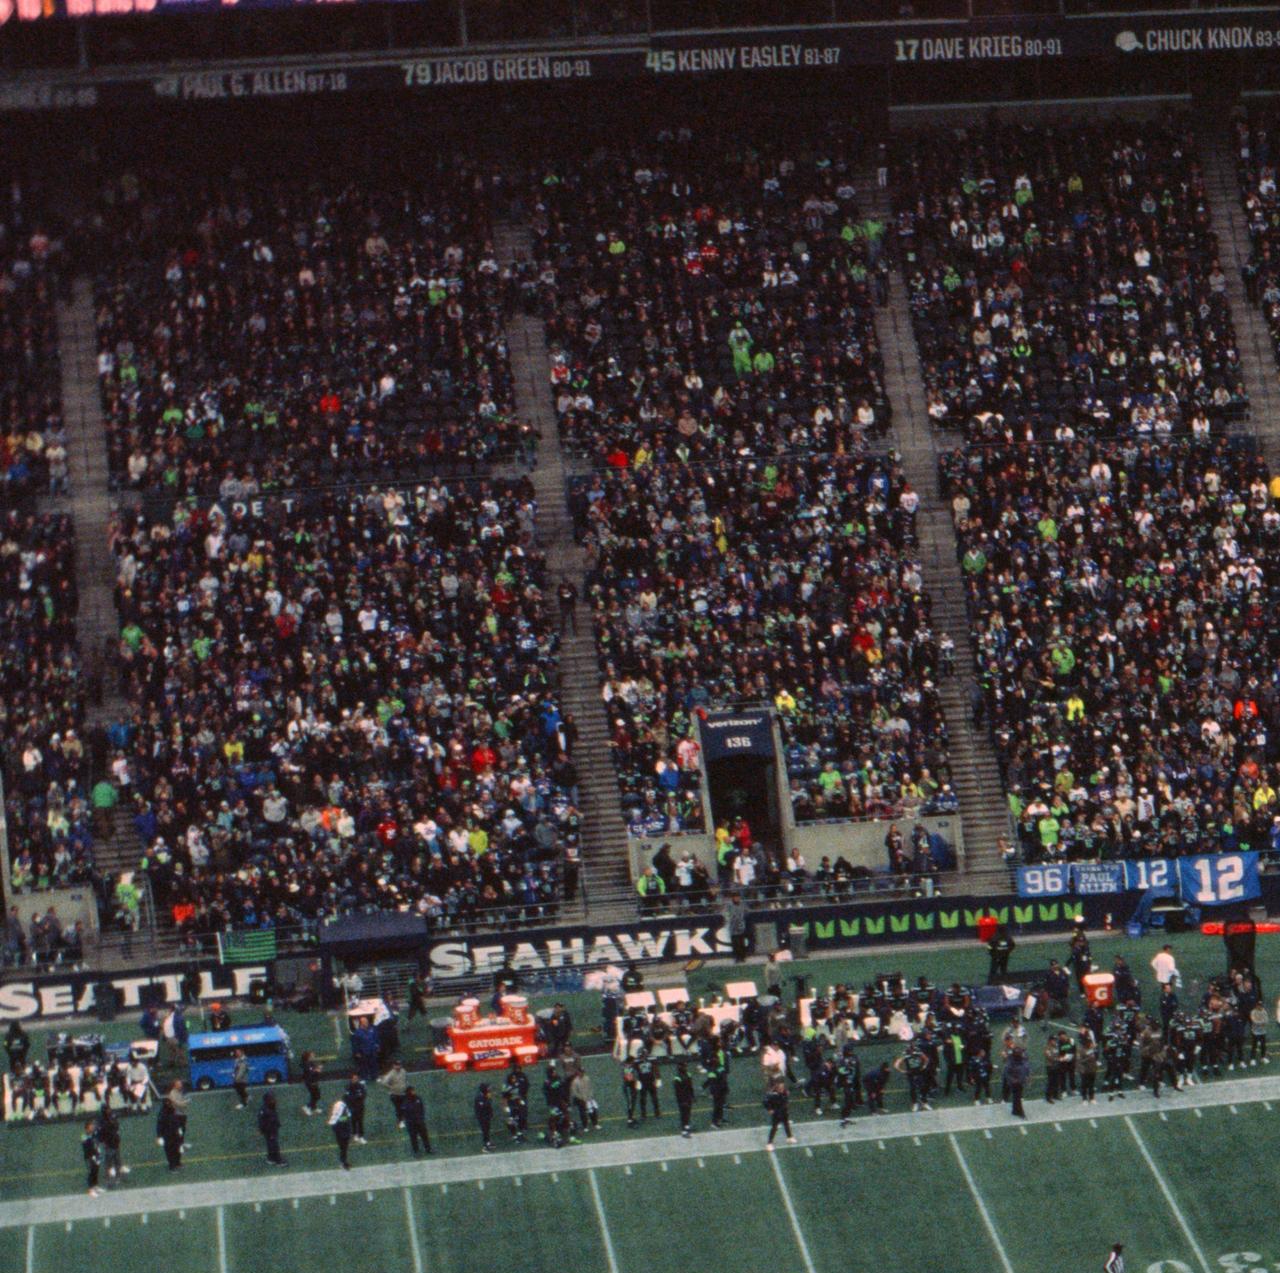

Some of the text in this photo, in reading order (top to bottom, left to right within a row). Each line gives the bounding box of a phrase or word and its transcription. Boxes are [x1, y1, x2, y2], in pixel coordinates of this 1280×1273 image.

[895, 36, 1063, 61] 17 DAVE KRIEG 80-91
[1145, 28, 1204, 53] CHUCK
[1207, 26, 1255, 50] KNOX
[645, 50, 676, 72] 45
[679, 47, 736, 71] KENNY
[740, 45, 802, 69] EASLEY
[254, 71, 306, 96] ALLEN
[402, 61, 432, 86] 79
[434, 60, 488, 85] JACOB
[493, 57, 551, 82] GREEN
[707, 718, 760, 728] verizon
[726, 737, 752, 748] 136
[1024, 868, 1063, 894] 96
[1081, 872, 1112, 882] PAUL
[1136, 860, 1168, 889] 12
[1194, 855, 1245, 902] 12
[1079, 882, 1118, 894] ALLEN
[468, 1036, 523, 1049] GATORADE
